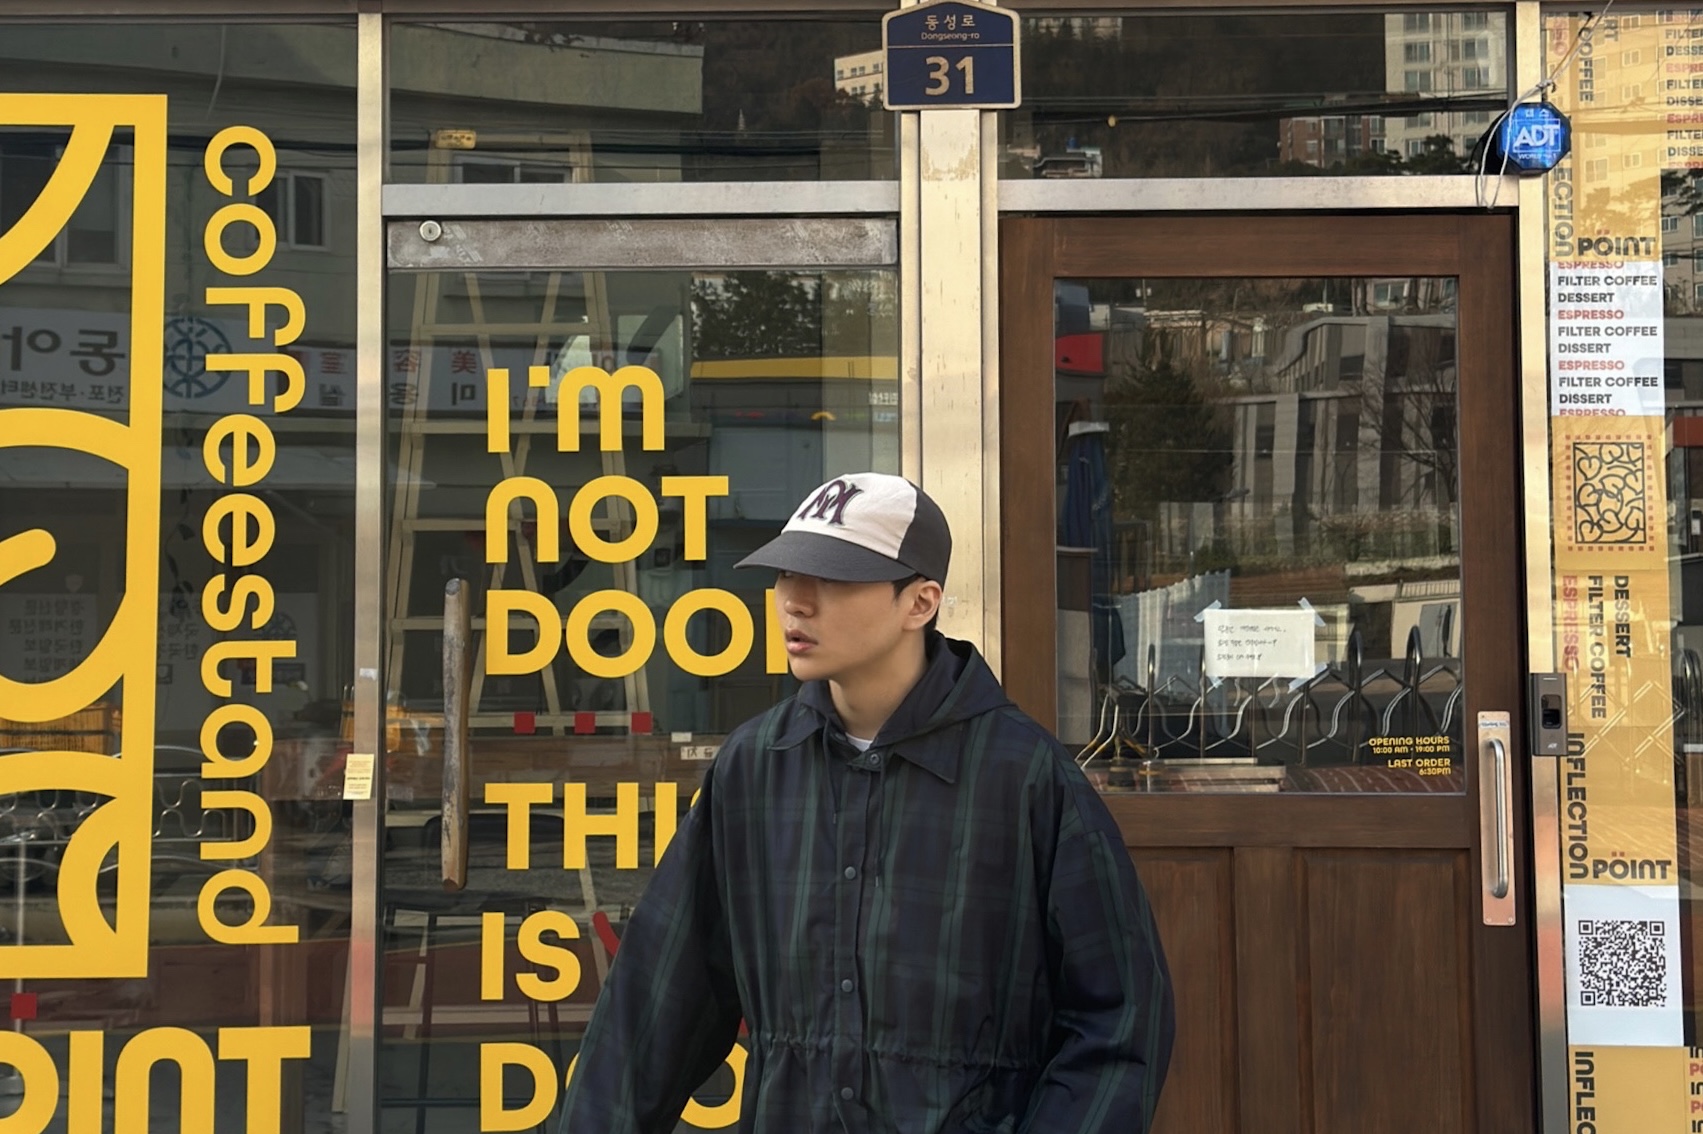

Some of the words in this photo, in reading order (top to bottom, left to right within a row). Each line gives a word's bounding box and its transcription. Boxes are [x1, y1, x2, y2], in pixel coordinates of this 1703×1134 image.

[925, 14, 975, 31] 동성로
[921, 31, 980, 42] Dongseong-ro
[925, 55, 974, 96] 31
[1513, 124, 1559, 149] ADT
[1557, 261, 1624, 269] ESPRESSO
[1558, 276, 1600, 286] FILTER
[1604, 276, 1657, 286] COFFEE
[1558, 293, 1615, 303] DESSERT
[1558, 310, 1624, 320] ESPRESSO
[1558, 326, 1601, 337] FILTER
[1604, 326, 1658, 337] COFFEE
[1558, 343, 1611, 353] DISSERT
[1558, 360, 1625, 370] ESPRESSO
[1559, 377, 1601, 387] FILTER
[1605, 377, 1658, 387] COFFEE
[1559, 394, 1612, 404] DISSERT
[197, 125, 306, 945] coffeestand
[1588, 575, 1604, 636] FILTER
[1614, 575, 1631, 658] DESSERT
[1563, 575, 1579, 672] ESPRESSO
[1589, 639, 1607, 719] COFFEE
[1368, 737, 1413, 746] OPENING
[1415, 736, 1450, 744] HOURS
[1373, 746, 1392, 754] 10:00
[1388, 759, 1413, 768] LAST
[1415, 758, 1451, 767] ORDER
[484, 782, 702, 870] THI
[480, 910, 581, 1002] IS
